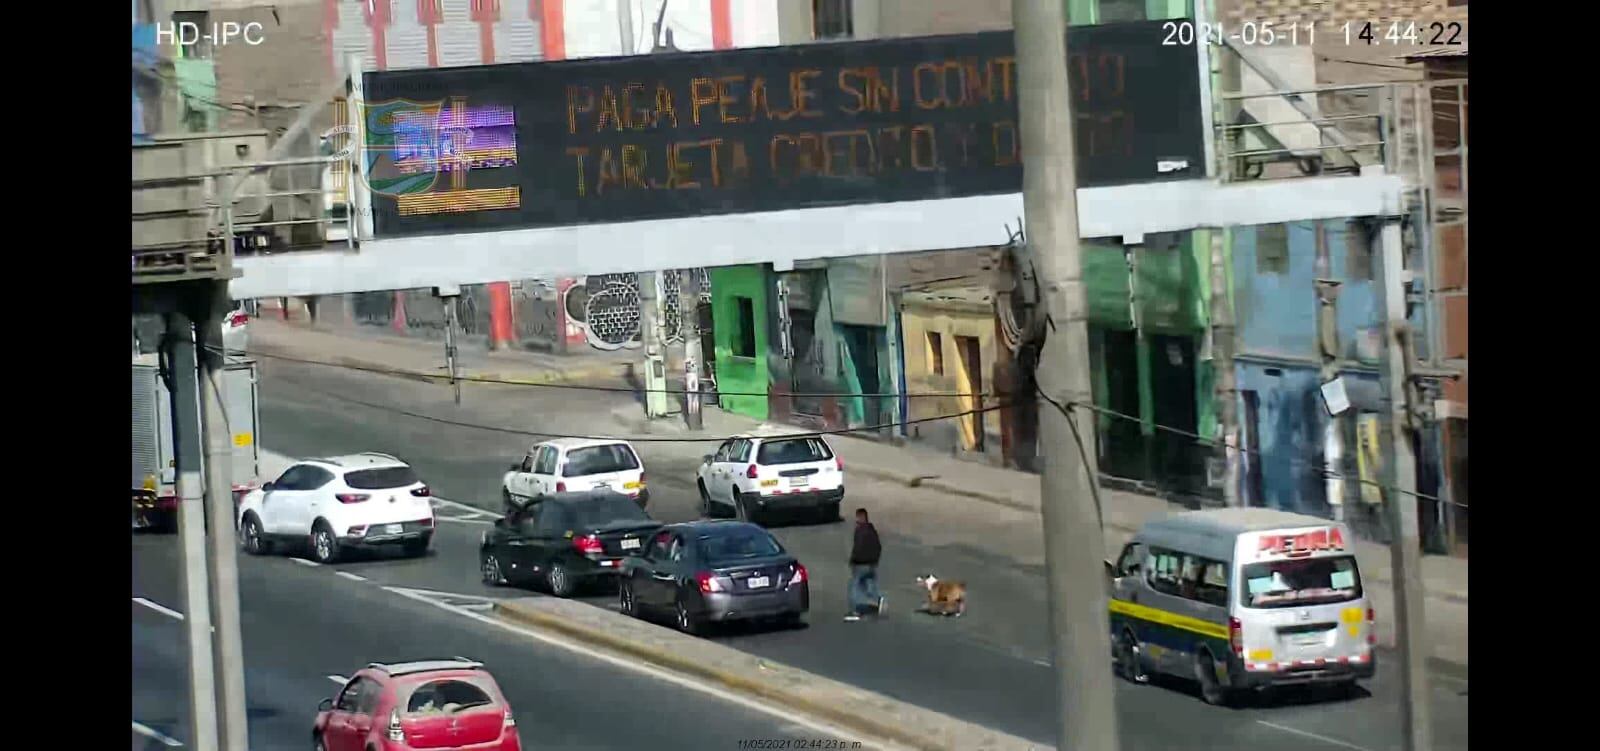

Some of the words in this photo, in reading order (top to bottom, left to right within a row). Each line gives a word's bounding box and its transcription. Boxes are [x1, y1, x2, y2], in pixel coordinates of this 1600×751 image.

[566, 82, 678, 134] PAGA
[691, 70, 824, 127] PEAJE
[838, 66, 900, 114] SIN
